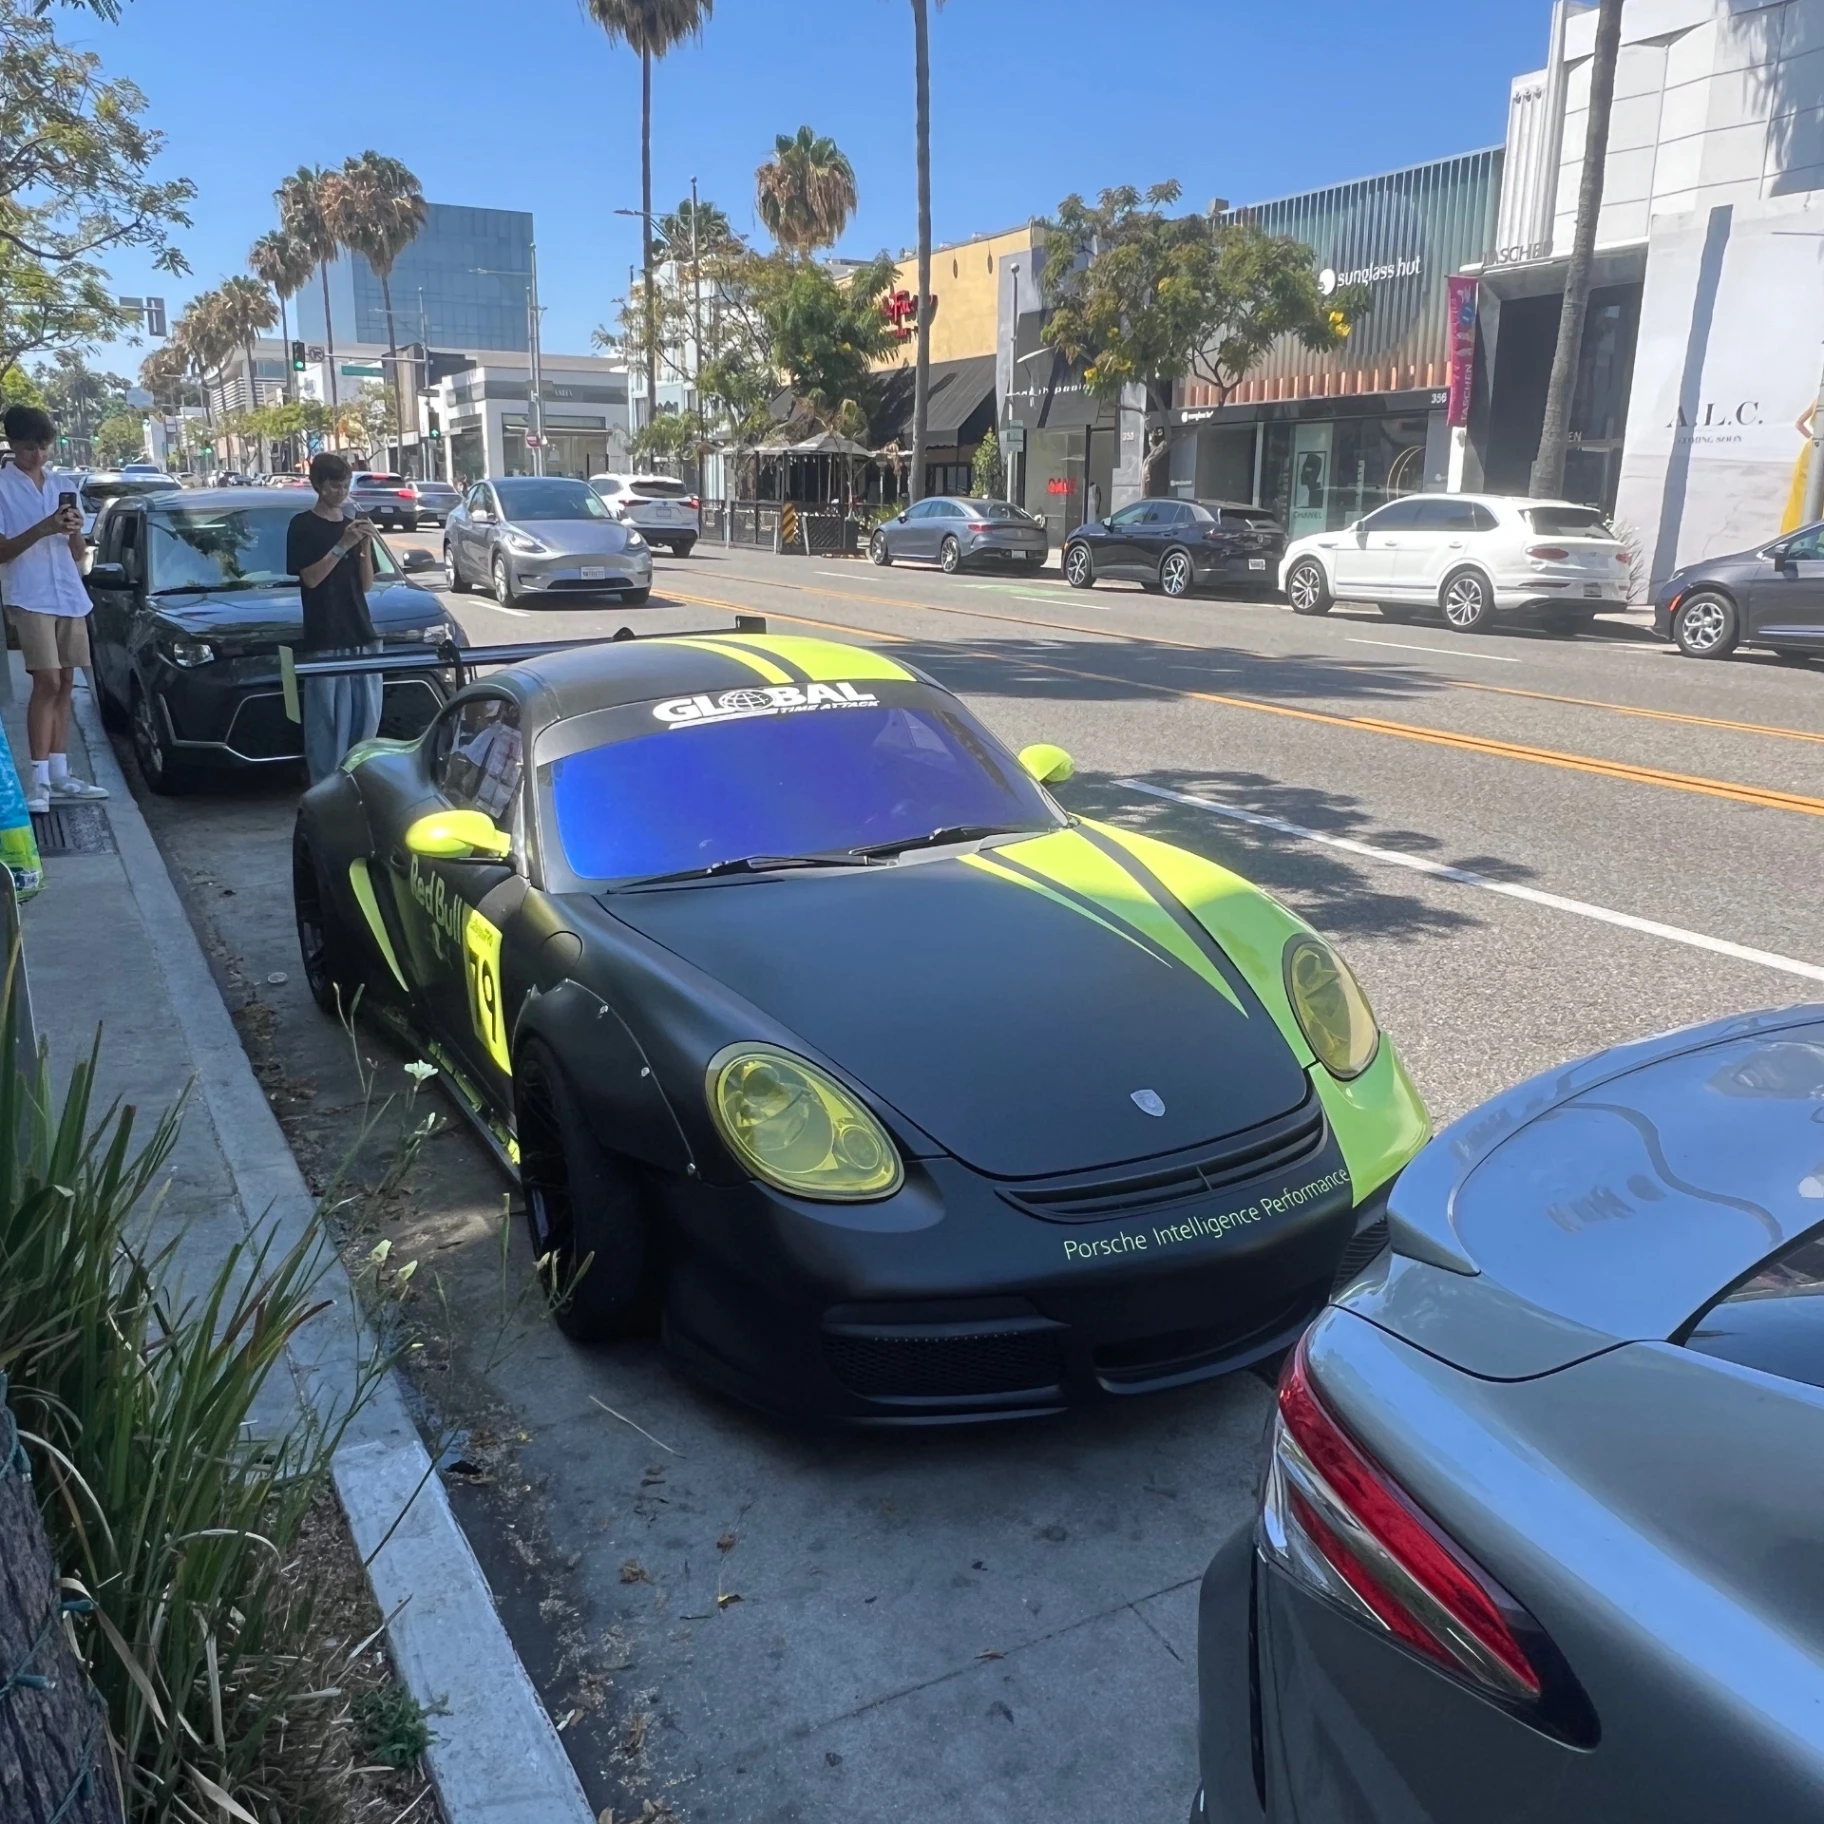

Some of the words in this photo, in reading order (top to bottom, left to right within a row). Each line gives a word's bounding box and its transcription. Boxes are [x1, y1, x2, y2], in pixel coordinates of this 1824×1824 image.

[1337, 261, 1395, 287] sunglass
[1396, 255, 1422, 277] hut
[1460, 363, 1473, 422] TASCHEN
[1665, 400, 1763, 428] A.L.C.
[1292, 510, 1322, 520] CHANEL
[652, 682, 877, 722] GLOBAL
[780, 704, 819, 714] TIME
[820, 700, 880, 711] ATTACK
[1063, 1231, 1148, 1261] Porsche
[1152, 1207, 1261, 1246] Intelligence
[1260, 1167, 1351, 1217] Performance
